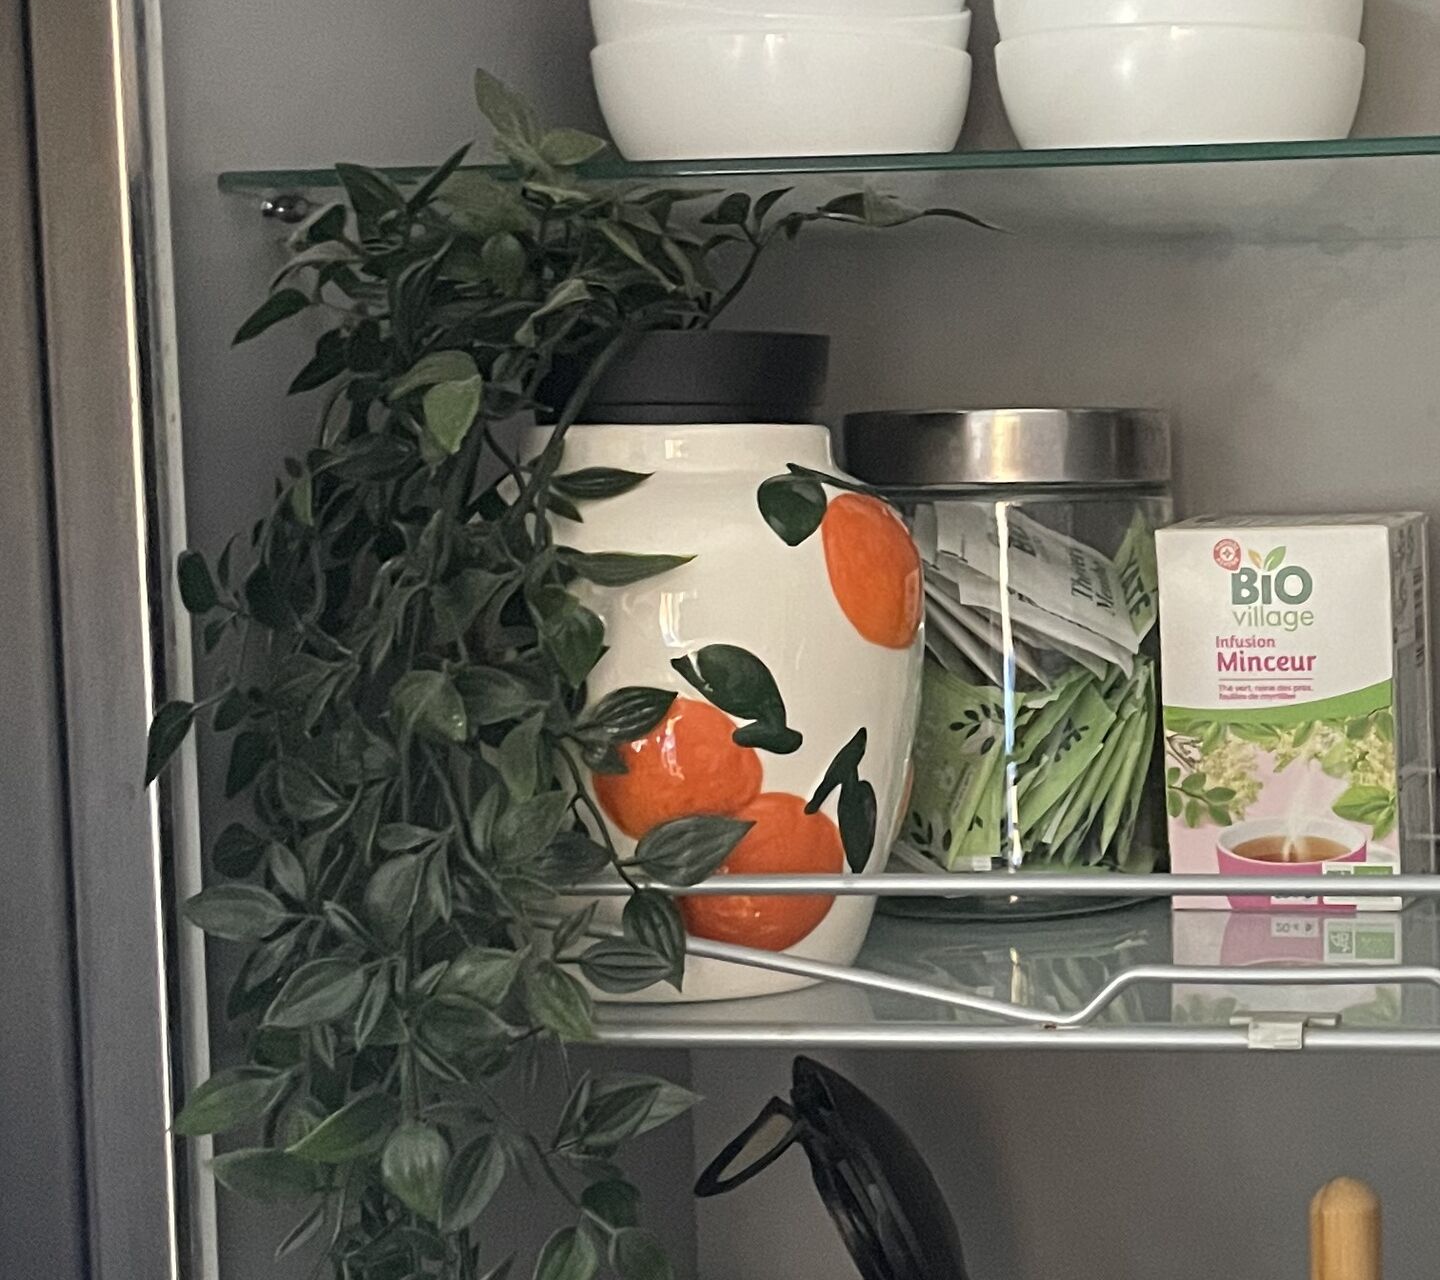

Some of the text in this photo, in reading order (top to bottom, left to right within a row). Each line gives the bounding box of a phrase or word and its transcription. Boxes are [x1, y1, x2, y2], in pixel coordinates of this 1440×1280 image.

[1232, 606, 1314, 632] village
[1215, 635, 1275, 648] Infusion
[1217, 651, 1316, 672] Minceur
